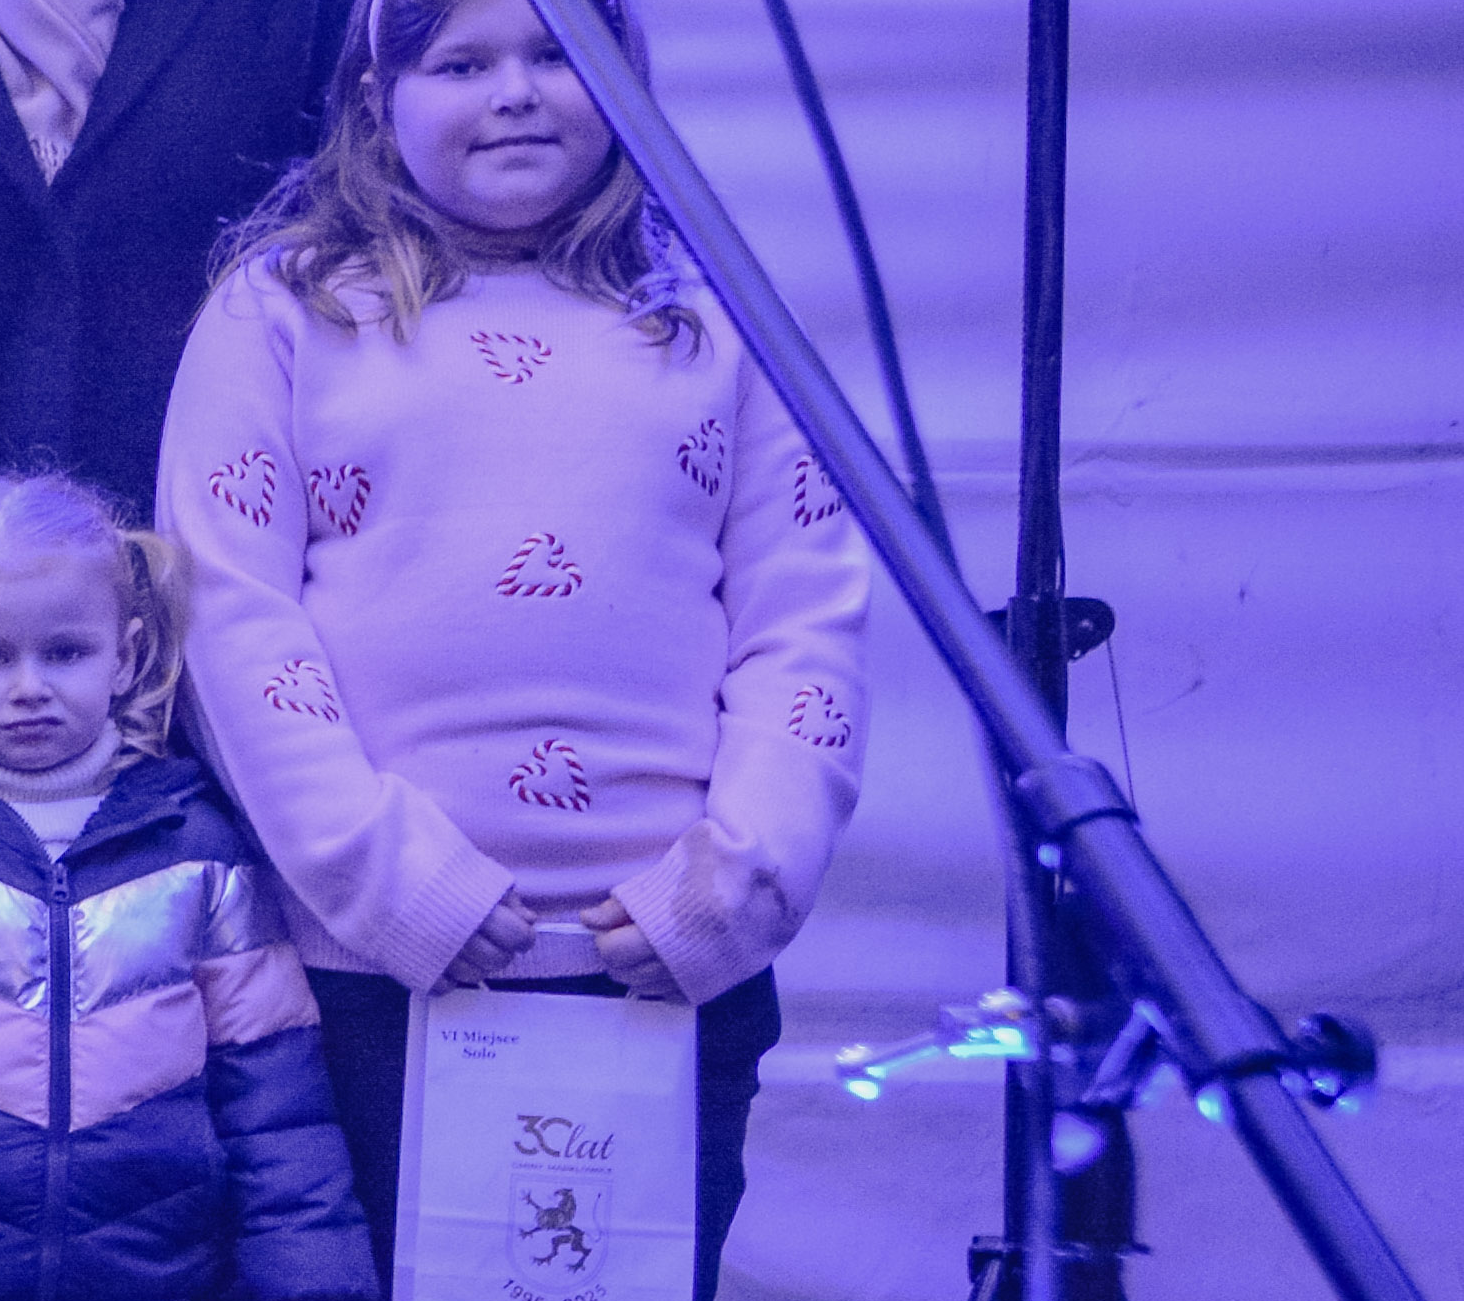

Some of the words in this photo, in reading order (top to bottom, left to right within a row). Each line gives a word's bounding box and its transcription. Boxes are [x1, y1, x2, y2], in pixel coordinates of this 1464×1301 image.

[462, 1030, 521, 1046] Miejsce
[461, 1045, 497, 1060] Solo
[564, 1122, 616, 1160] lat
